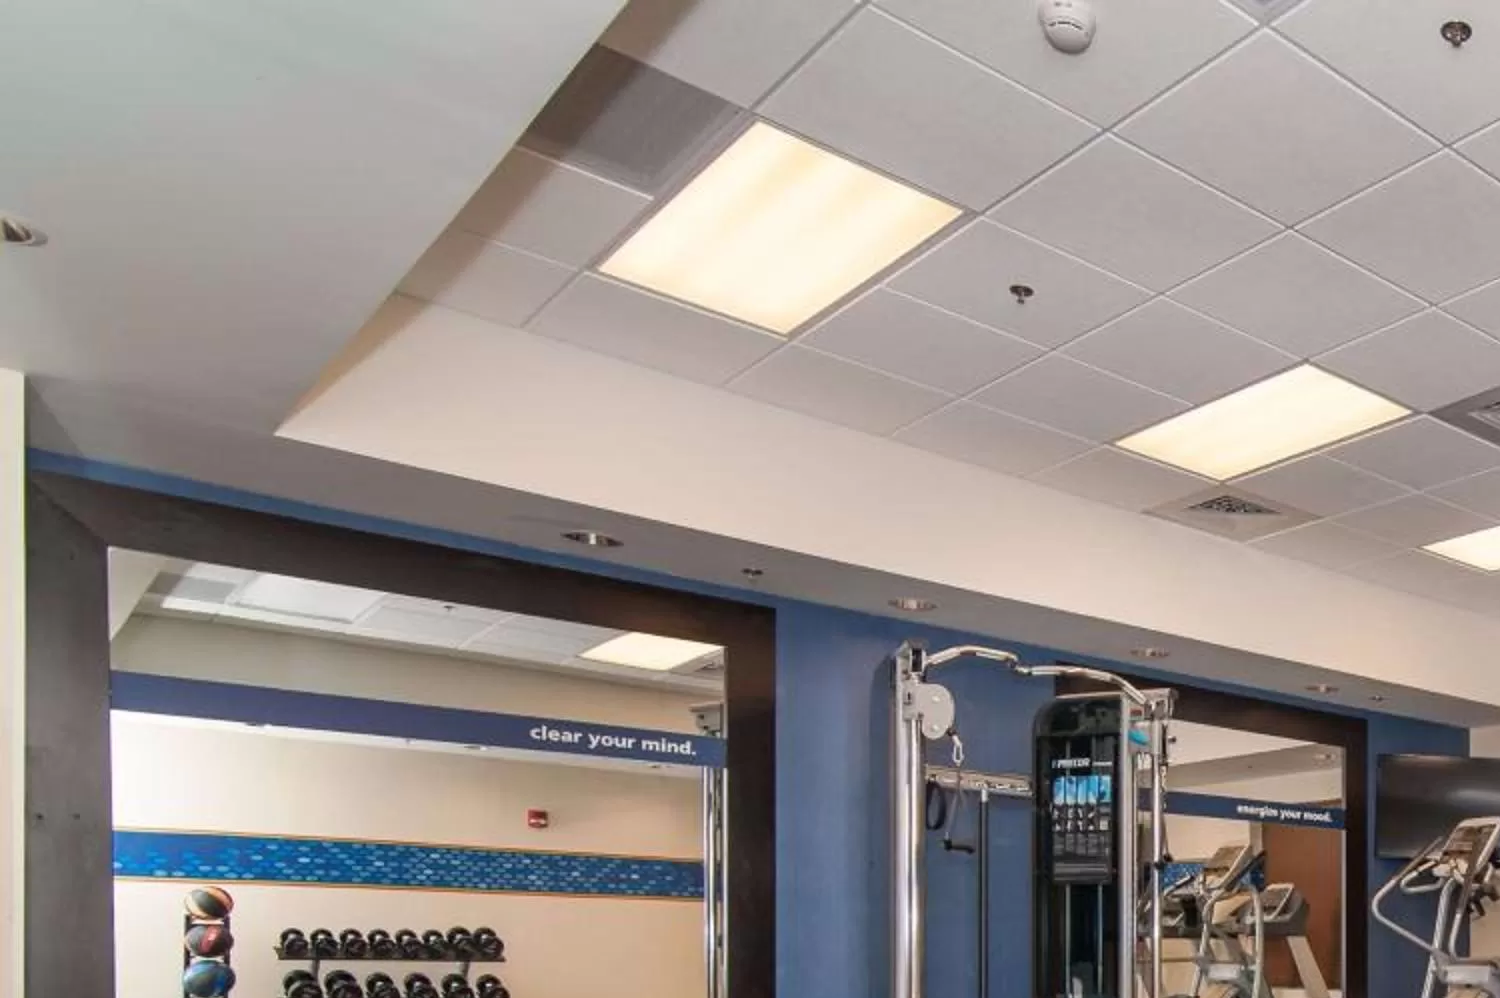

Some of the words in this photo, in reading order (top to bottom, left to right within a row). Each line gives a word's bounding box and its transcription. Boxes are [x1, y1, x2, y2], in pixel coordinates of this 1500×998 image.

[529, 725, 582, 743] clear
[588, 732, 637, 749] your
[641, 738, 697, 756] mind.
[1280, 809, 1301, 821] your
